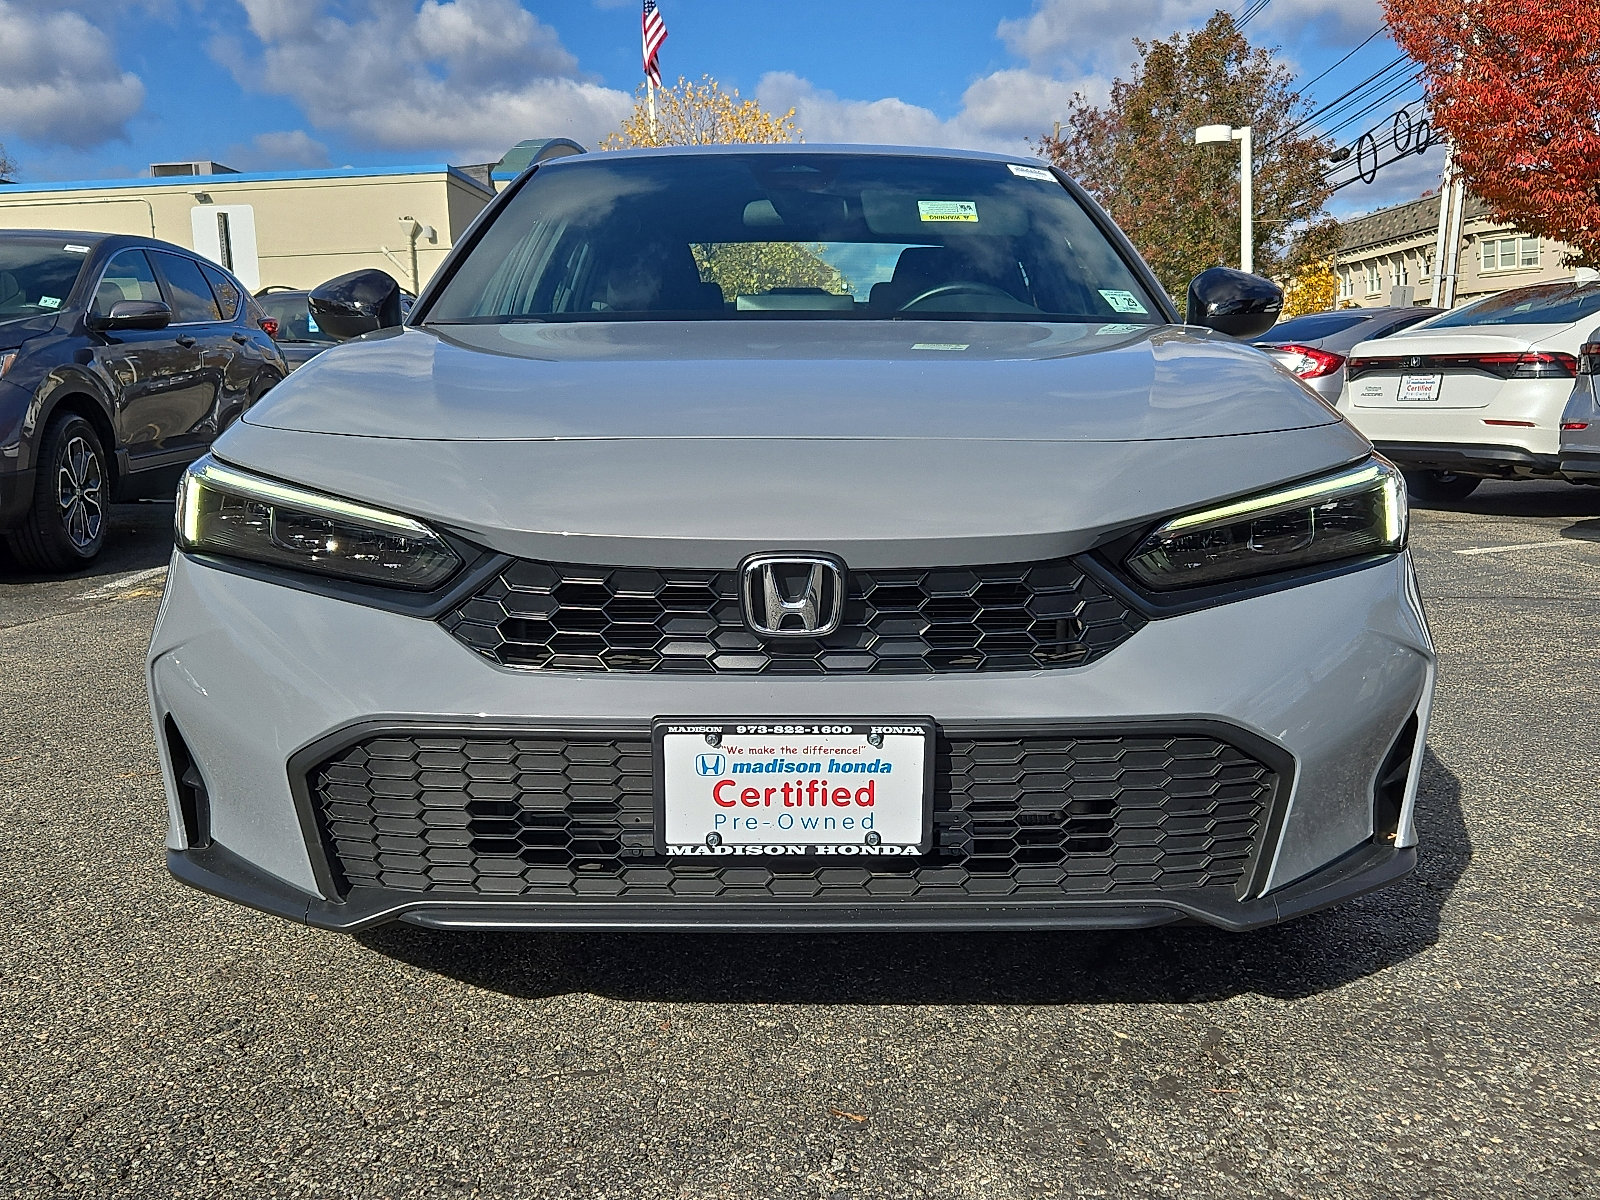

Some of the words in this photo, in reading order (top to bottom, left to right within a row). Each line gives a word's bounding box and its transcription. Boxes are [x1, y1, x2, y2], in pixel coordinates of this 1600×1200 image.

[1109, 296, 1120, 306] 7
[1123, 297, 1138, 307] 29
[1406, 384, 1433, 392] Certified
[736, 725, 853, 734] 973-822-1600
[870, 726, 926, 735] HONDA
[748, 745, 776, 755] make
[780, 745, 798, 755] the
[731, 758, 822, 774] madison
[827, 758, 893, 774] honda
[712, 779, 875, 808] Certified
[714, 811, 875, 830] Pre-Owned
[665, 845, 808, 856] MADISON
[815, 845, 923, 856] HONDA
